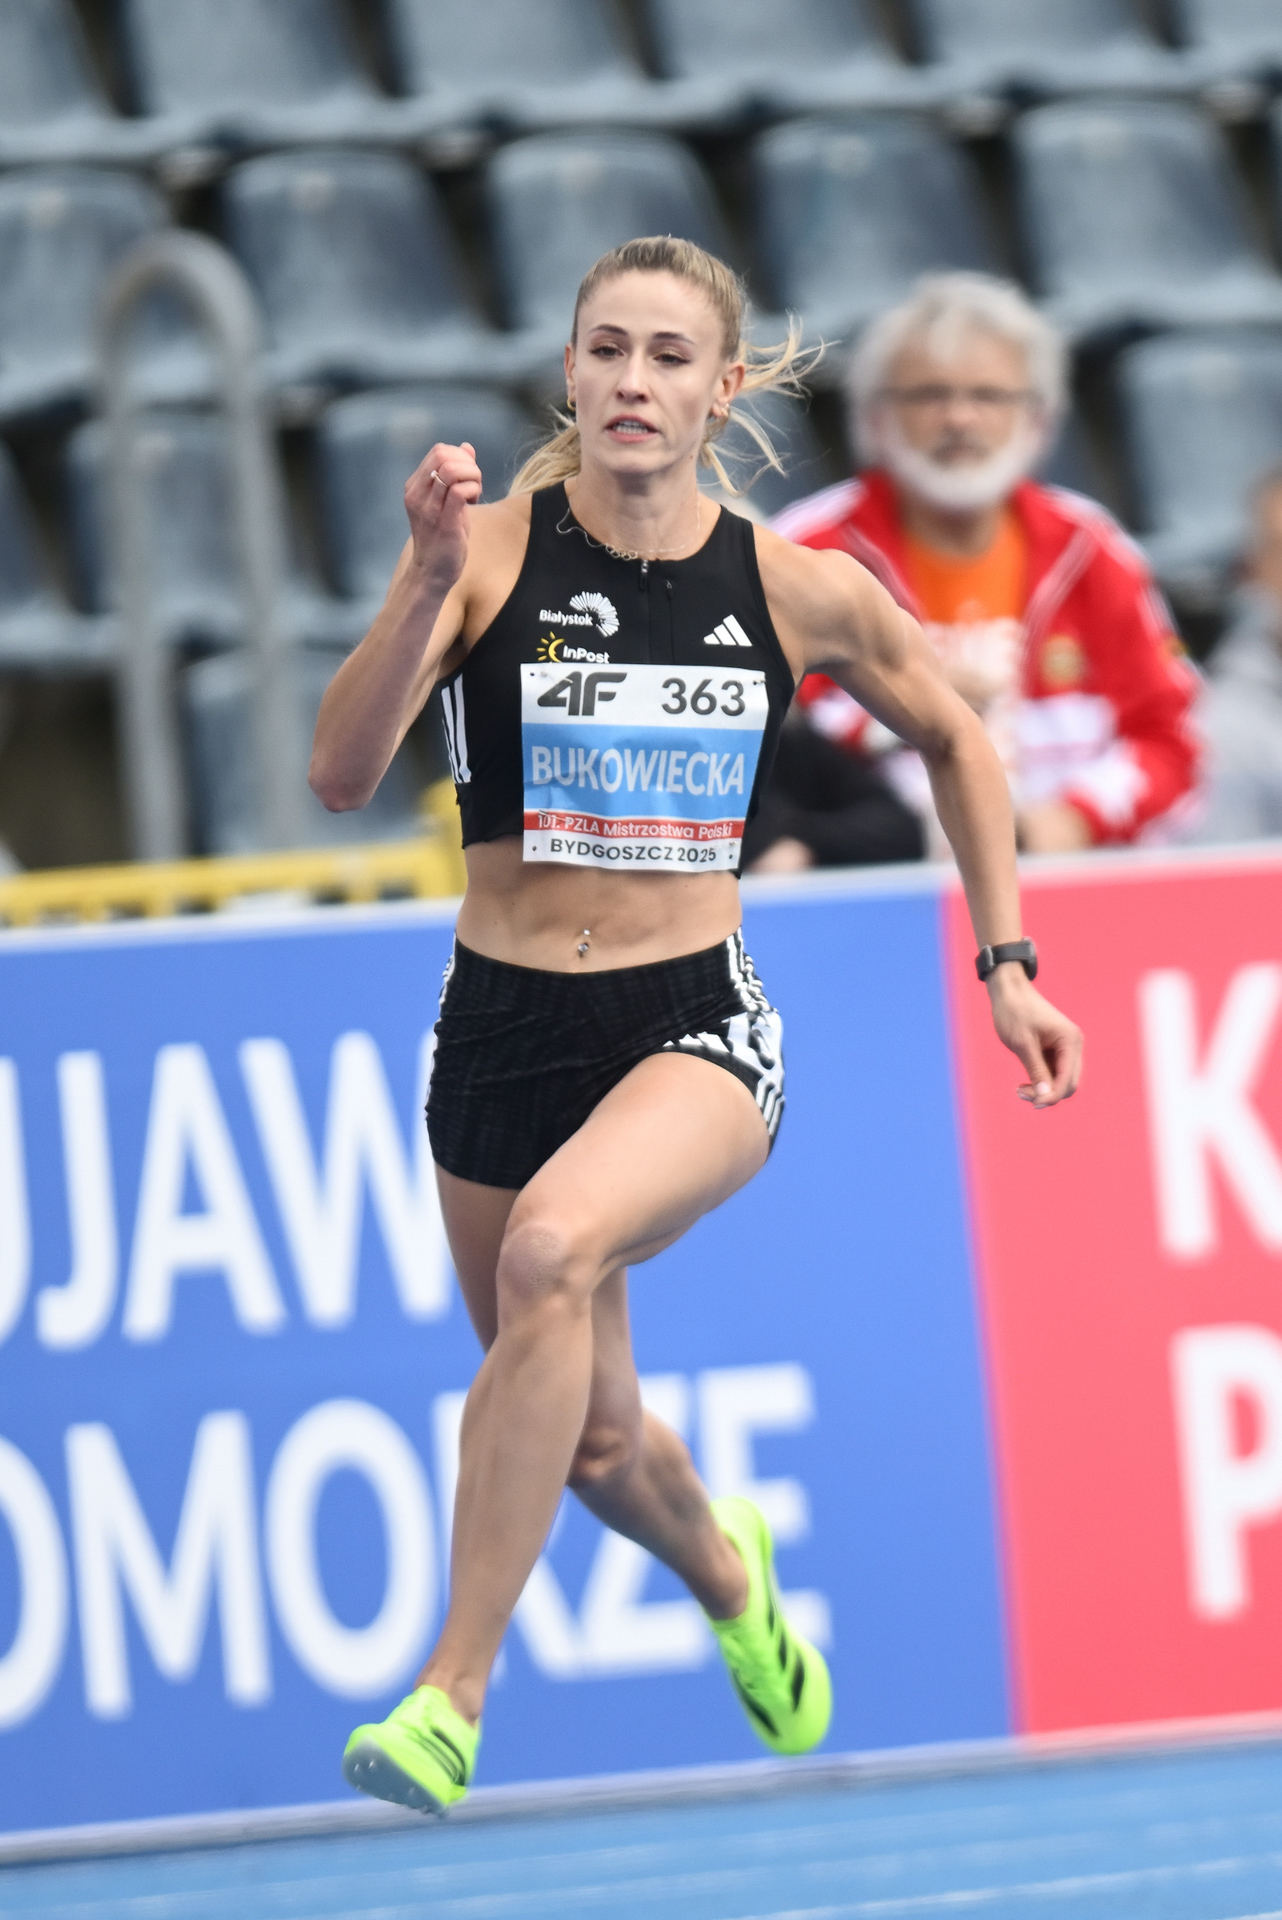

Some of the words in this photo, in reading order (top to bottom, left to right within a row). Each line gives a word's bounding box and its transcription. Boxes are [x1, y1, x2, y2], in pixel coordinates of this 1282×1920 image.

[563, 645, 610, 664] InPost
[661, 677, 745, 716] 363
[531, 746, 744, 796] BUKOWIECKA
[538, 814, 560, 829] 101.
[565, 816, 600, 834] PZLA
[603, 822, 694, 838] Mistrzostwa
[698, 823, 733, 839] Polski
[550, 838, 673, 861] BYDGOSZCZ
[677, 847, 716, 863] 2025
